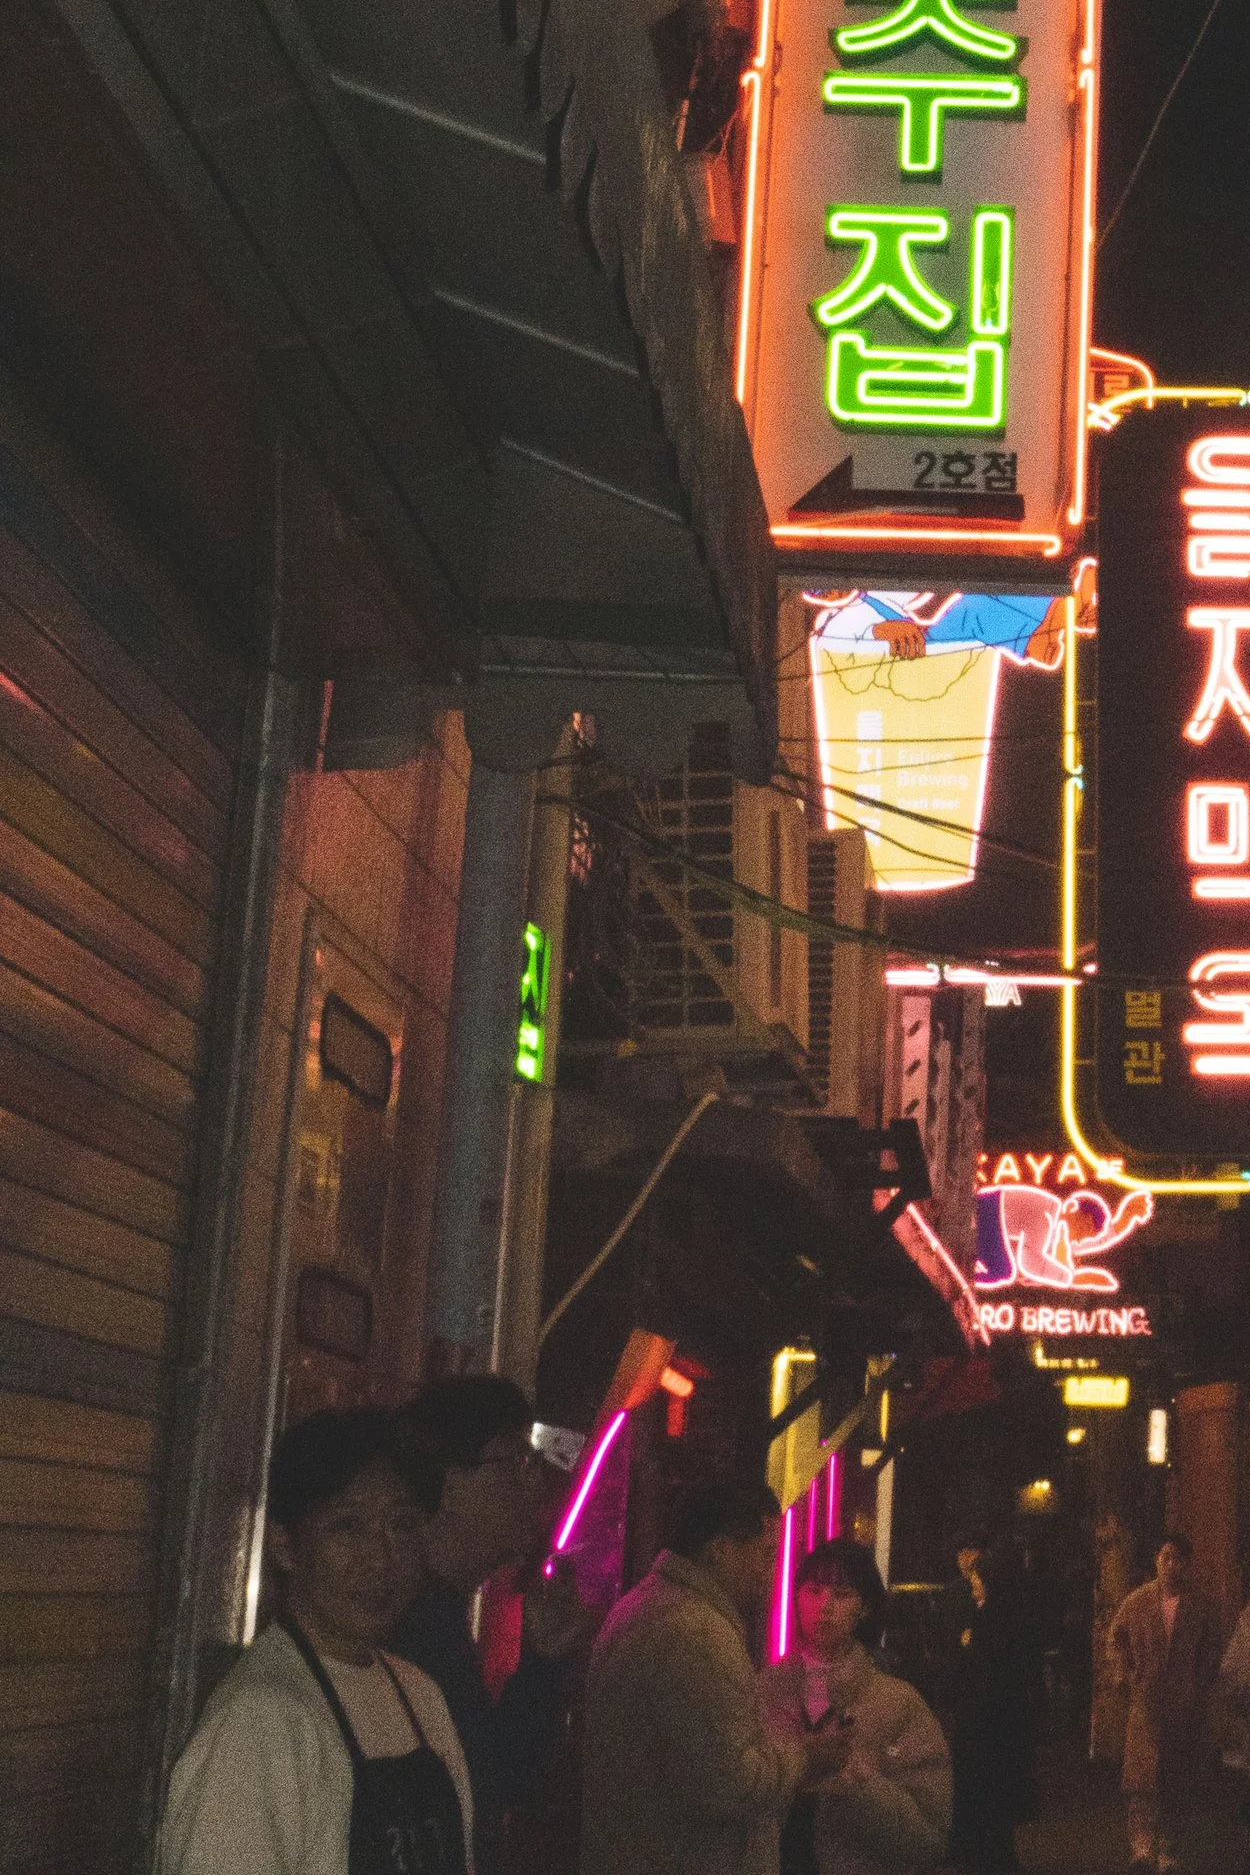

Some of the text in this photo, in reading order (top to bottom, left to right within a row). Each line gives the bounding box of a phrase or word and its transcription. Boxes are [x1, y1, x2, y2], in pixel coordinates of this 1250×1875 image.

[914, 450, 1018, 492] 2호점
[896, 770, 968, 790] Brewing
[1020, 1306, 1152, 1336] BREWING
